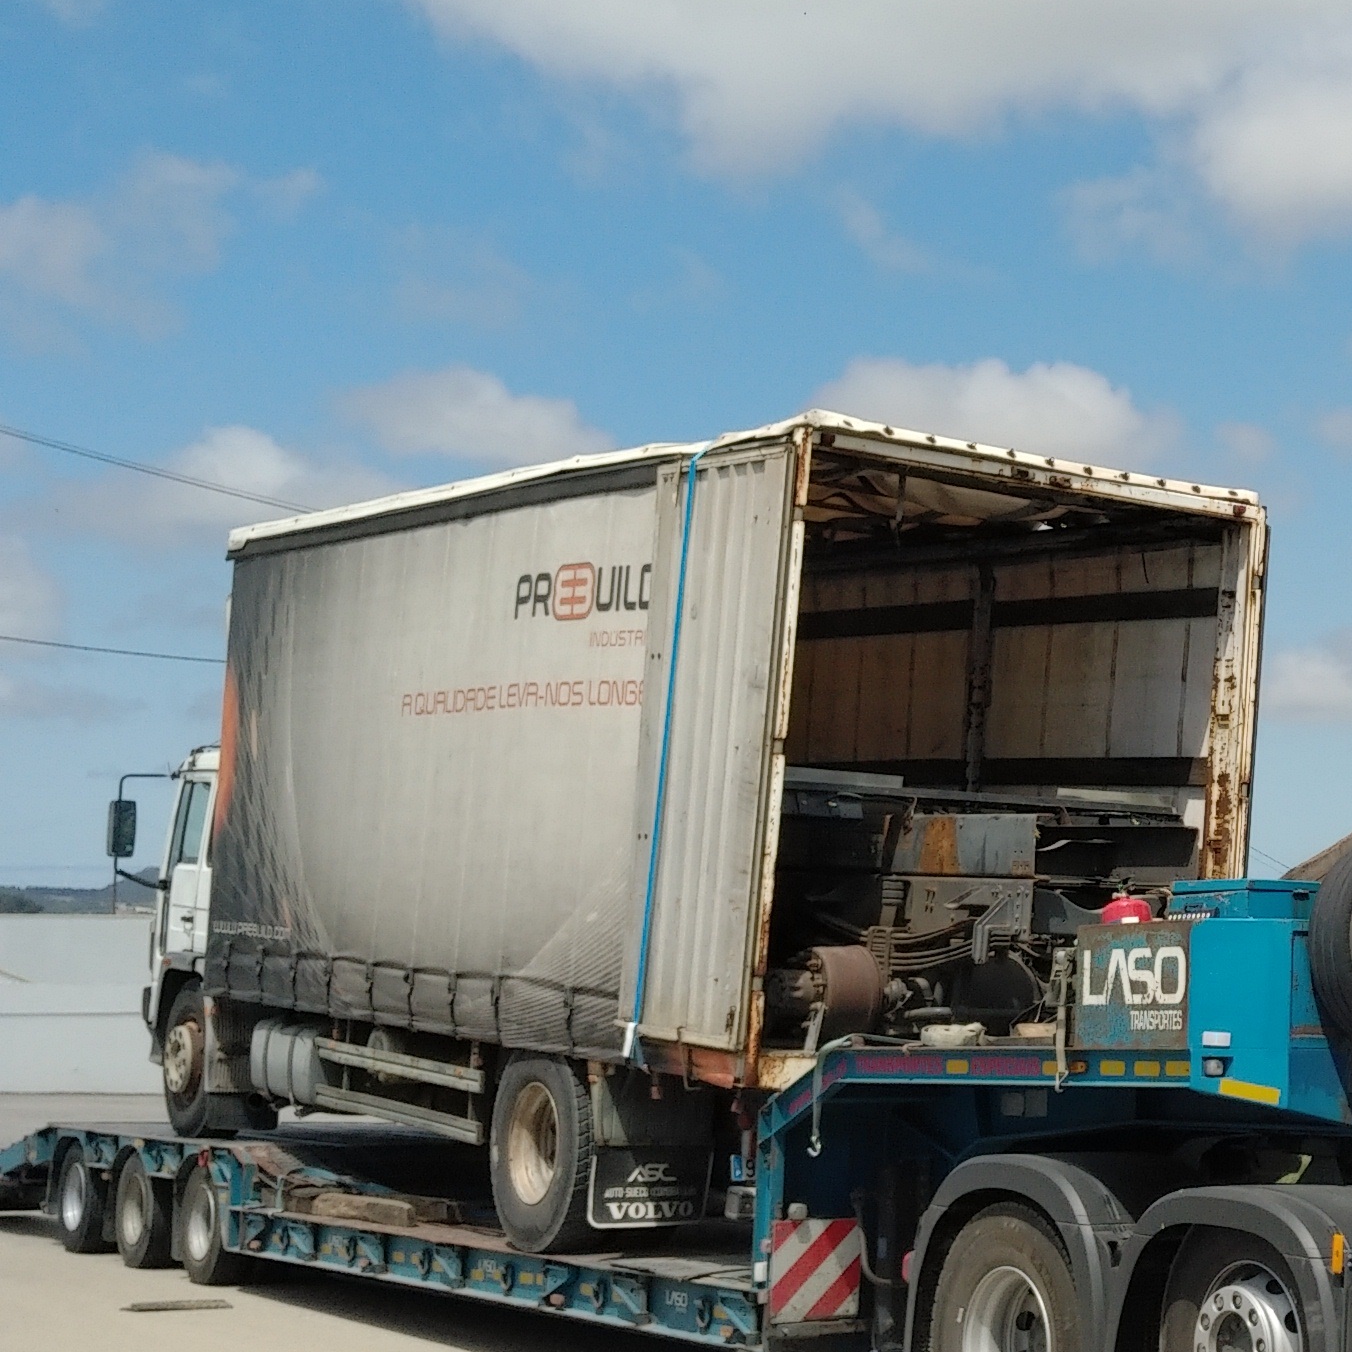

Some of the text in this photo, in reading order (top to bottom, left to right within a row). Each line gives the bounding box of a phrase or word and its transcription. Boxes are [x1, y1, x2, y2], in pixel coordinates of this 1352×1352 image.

[414, 686, 496, 716] QUALIDADE
[499, 681, 584, 708] LEVA-NOS
[1082, 946, 1187, 1006] LASO
[1130, 1009, 1183, 1030] TRANSPORTES
[606, 1201, 694, 1220] VOLVO
